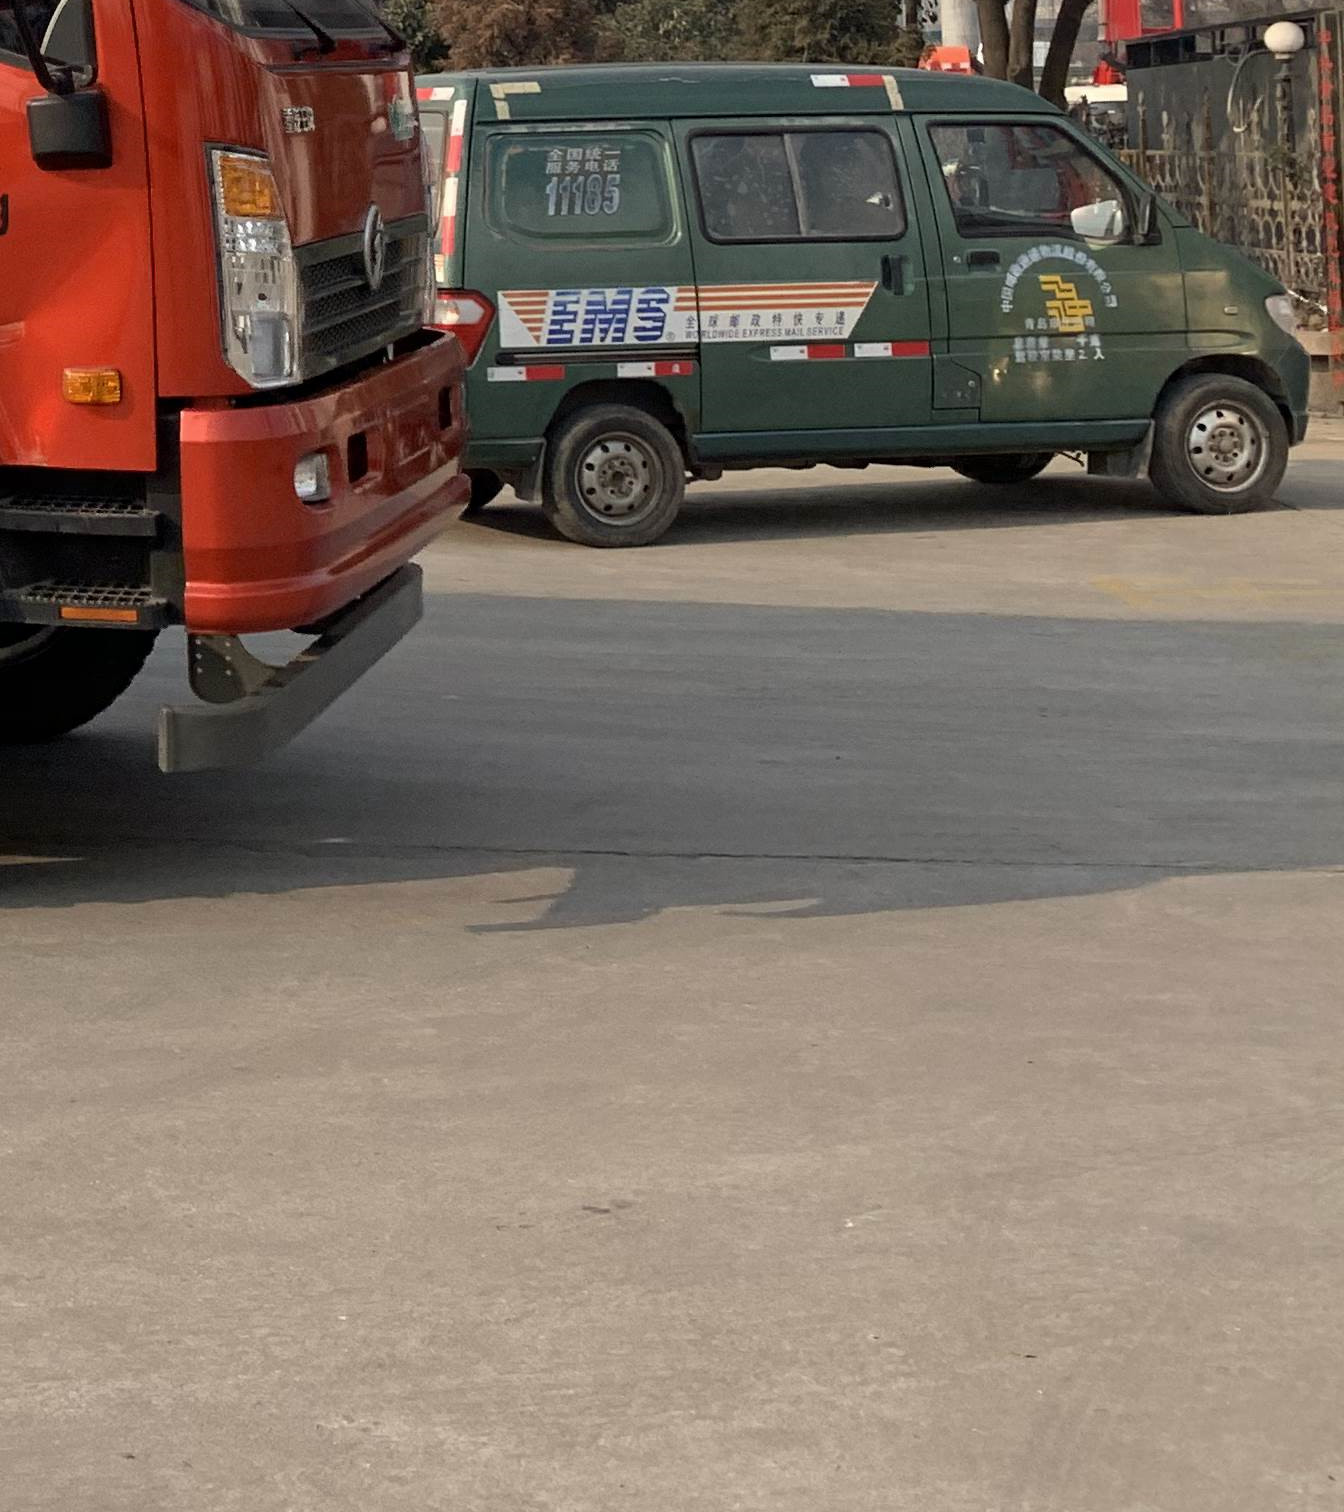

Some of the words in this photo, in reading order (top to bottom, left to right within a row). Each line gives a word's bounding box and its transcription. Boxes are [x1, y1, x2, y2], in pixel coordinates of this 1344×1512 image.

[545, 174, 621, 216] 11185
[546, 288, 671, 345] EMS
[742, 328, 782, 338] EXPRESS
[784, 327, 805, 337] MAIL
[806, 326, 844, 337] SERVICE
